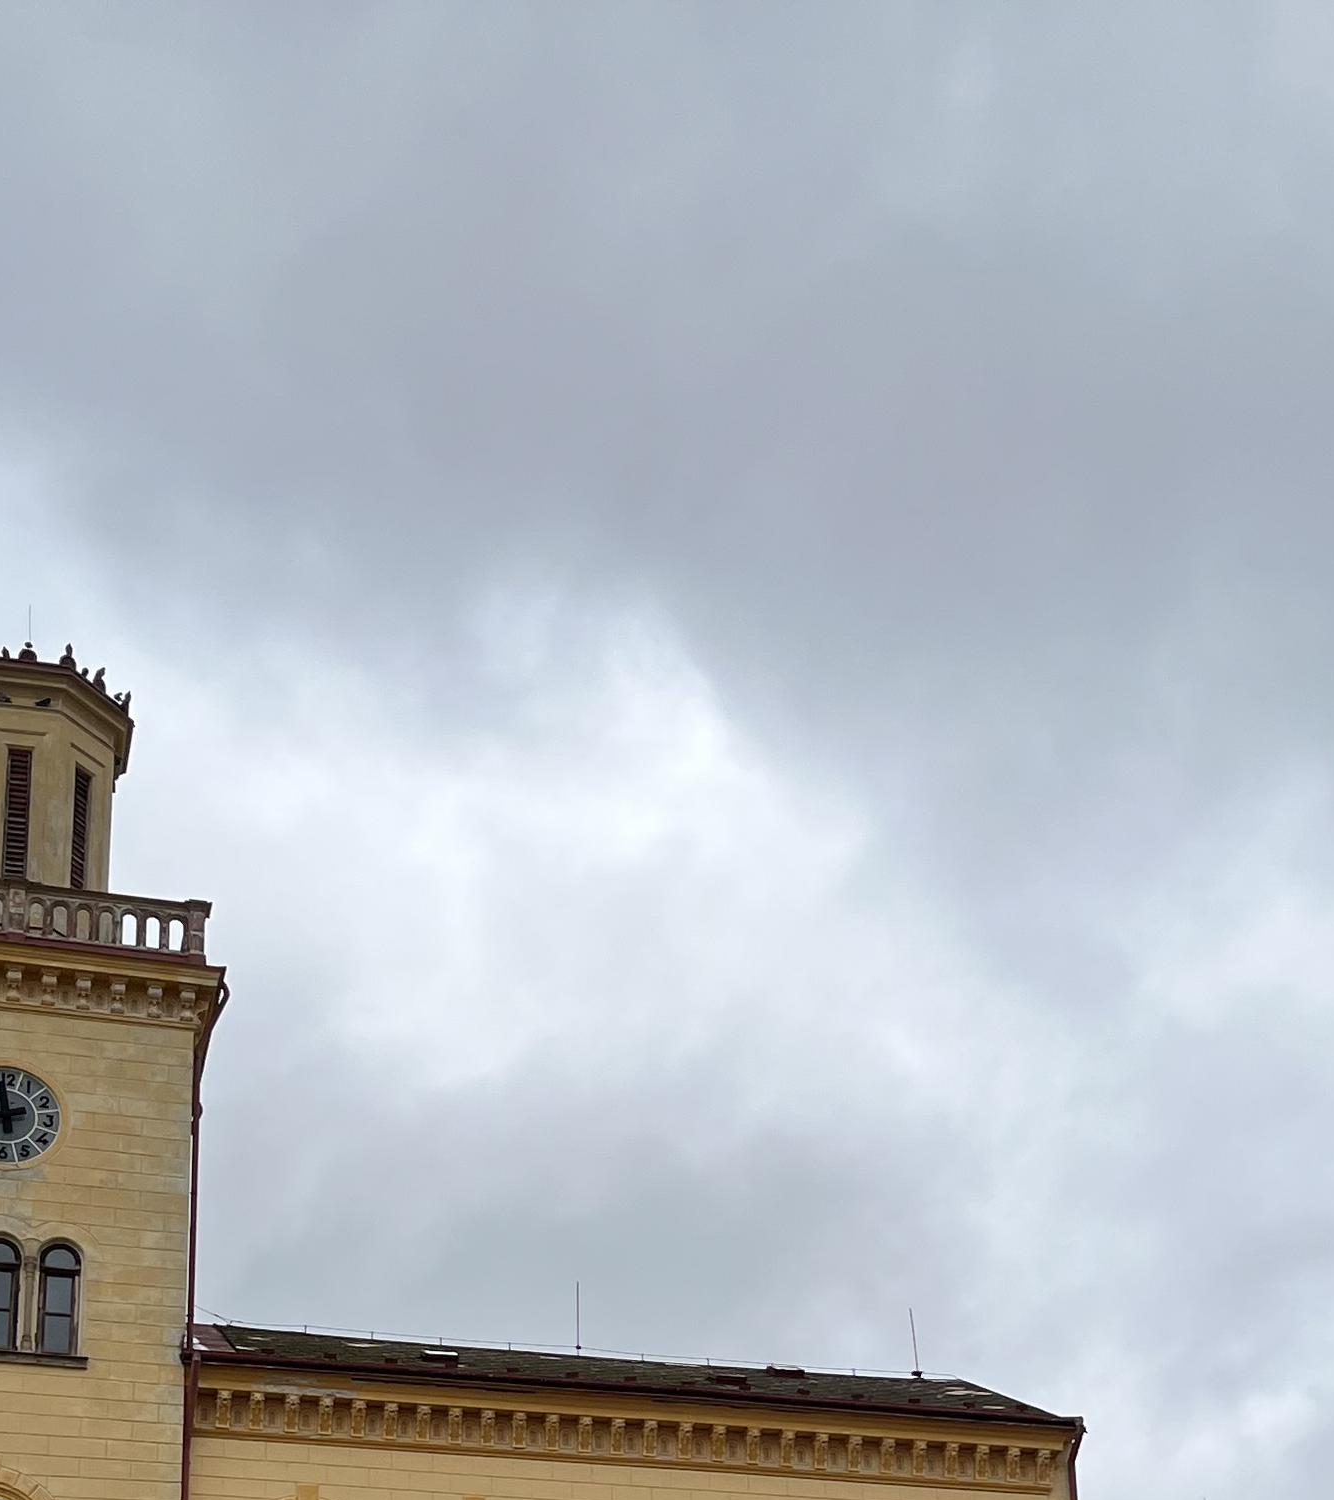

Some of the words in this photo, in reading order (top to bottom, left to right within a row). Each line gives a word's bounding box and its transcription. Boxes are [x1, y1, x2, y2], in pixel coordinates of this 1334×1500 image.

[39, 1096, 50, 1108] 2
[43, 1115, 54, 1127] 3
[35, 1133, 49, 1145] 4
[19, 1145, 30, 1157] 5
